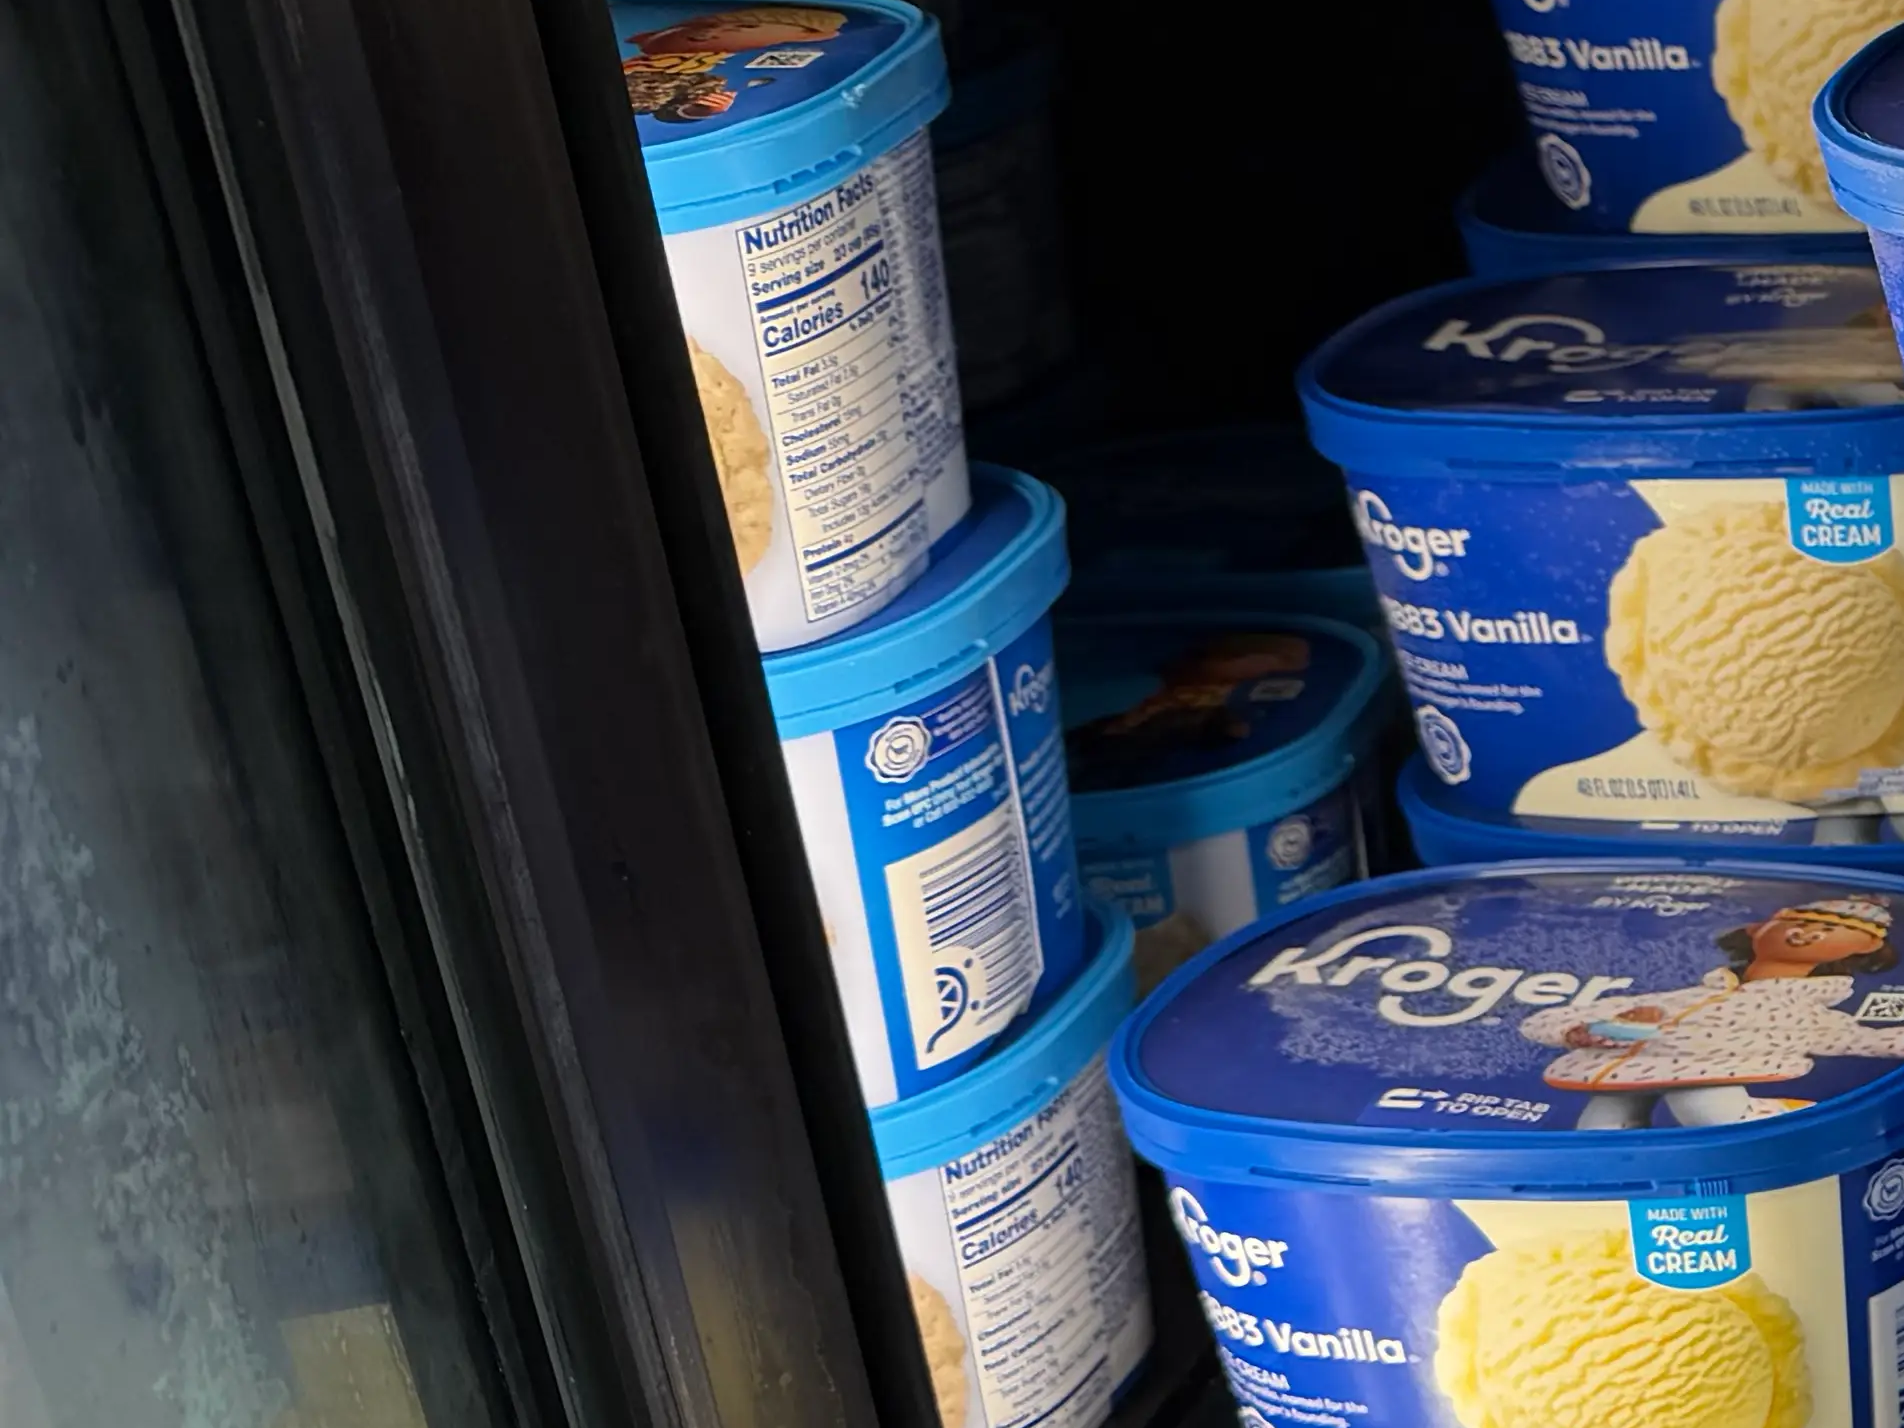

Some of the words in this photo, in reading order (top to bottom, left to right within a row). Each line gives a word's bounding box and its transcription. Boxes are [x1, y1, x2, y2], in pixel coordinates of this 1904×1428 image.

[742, 204, 835, 256] Nutrition
[762, 301, 844, 351] Calories
[1802, 523, 1882, 548] CREAM
[1456, 610, 1579, 646] Vanilla
[1251, 925, 1636, 1028] Kroger
[1266, 1324, 1407, 1365] Vanilla
